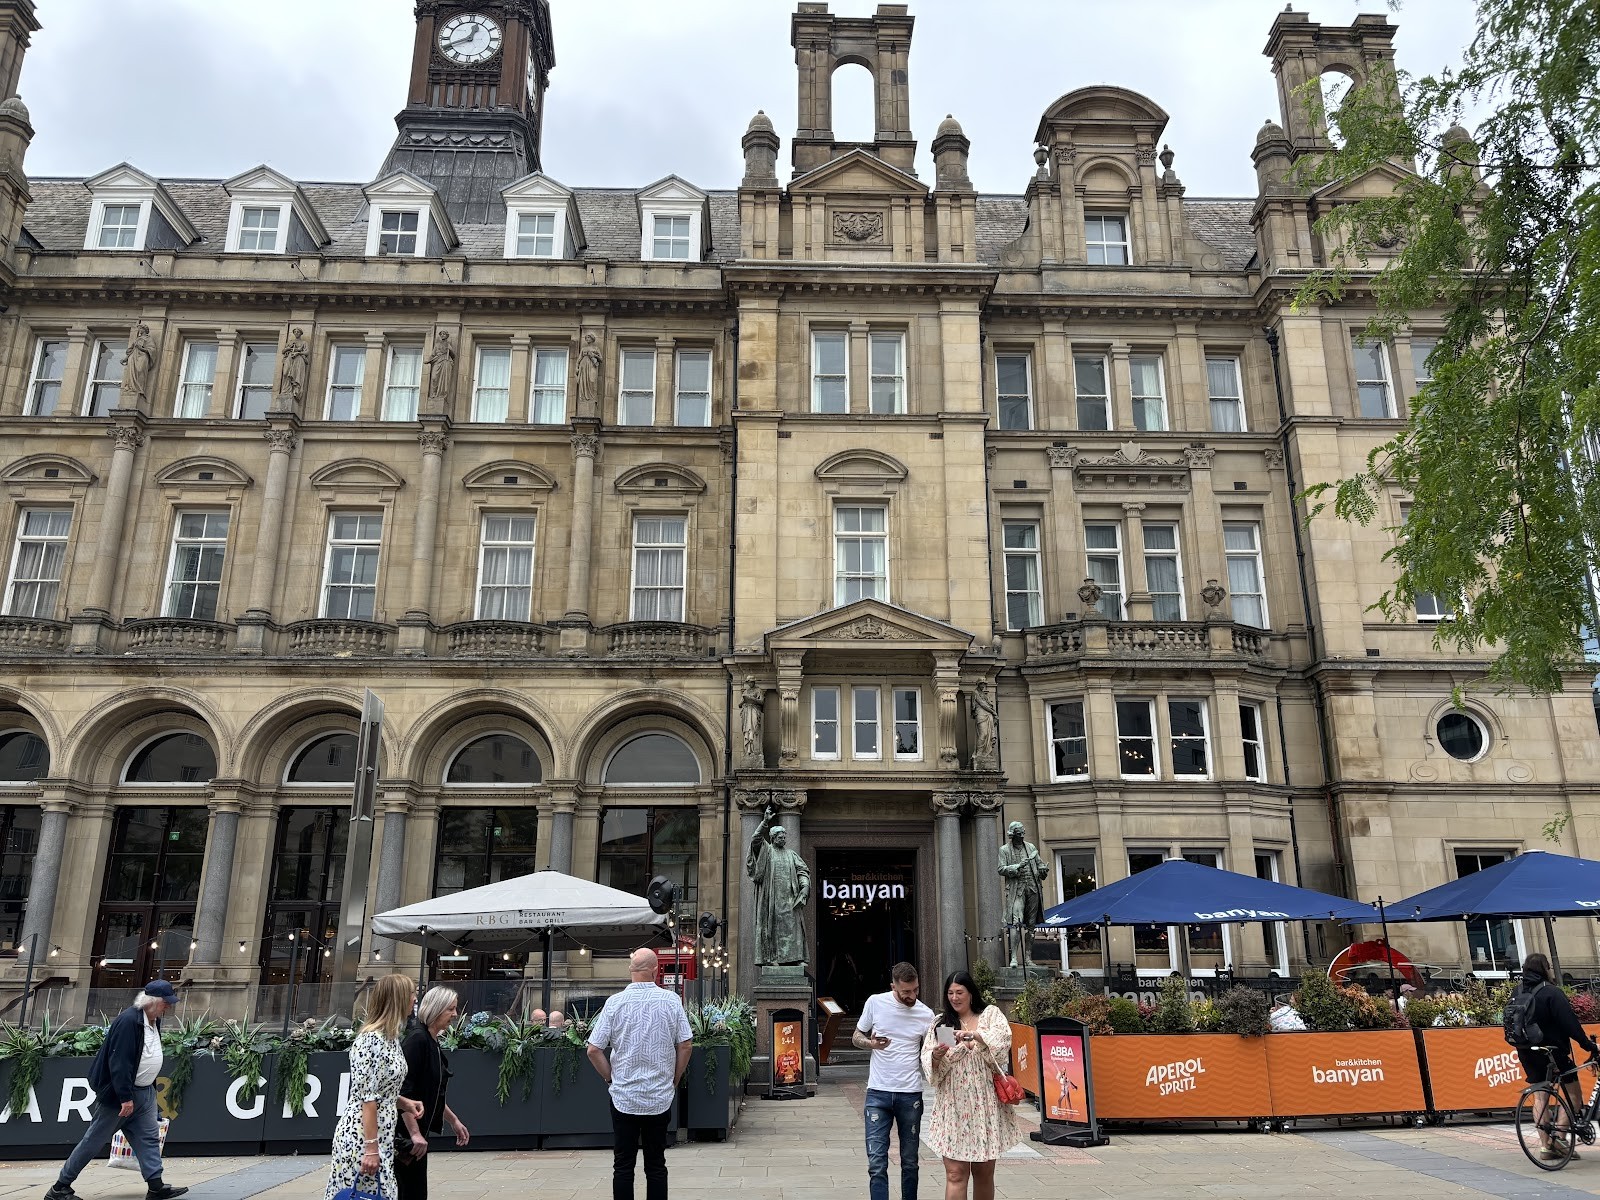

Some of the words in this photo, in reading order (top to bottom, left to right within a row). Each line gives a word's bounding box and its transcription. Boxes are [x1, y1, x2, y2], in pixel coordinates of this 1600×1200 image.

[851, 872, 904, 881] bar&kitchen
[822, 879, 905, 904] banyan
[1193, 908, 1290, 920] banyan
[1050, 1046, 1075, 1057] ABBA
[1145, 1057, 1206, 1087] APEROL
[1335, 1058, 1382, 1067] bar&kitchen
[1474, 1050, 1520, 1079] APERO
[1311, 1065, 1385, 1086] banyan
[1487, 1066, 1523, 1088] SPRITZ
[1159, 1076, 1197, 1096] SPRITZ
